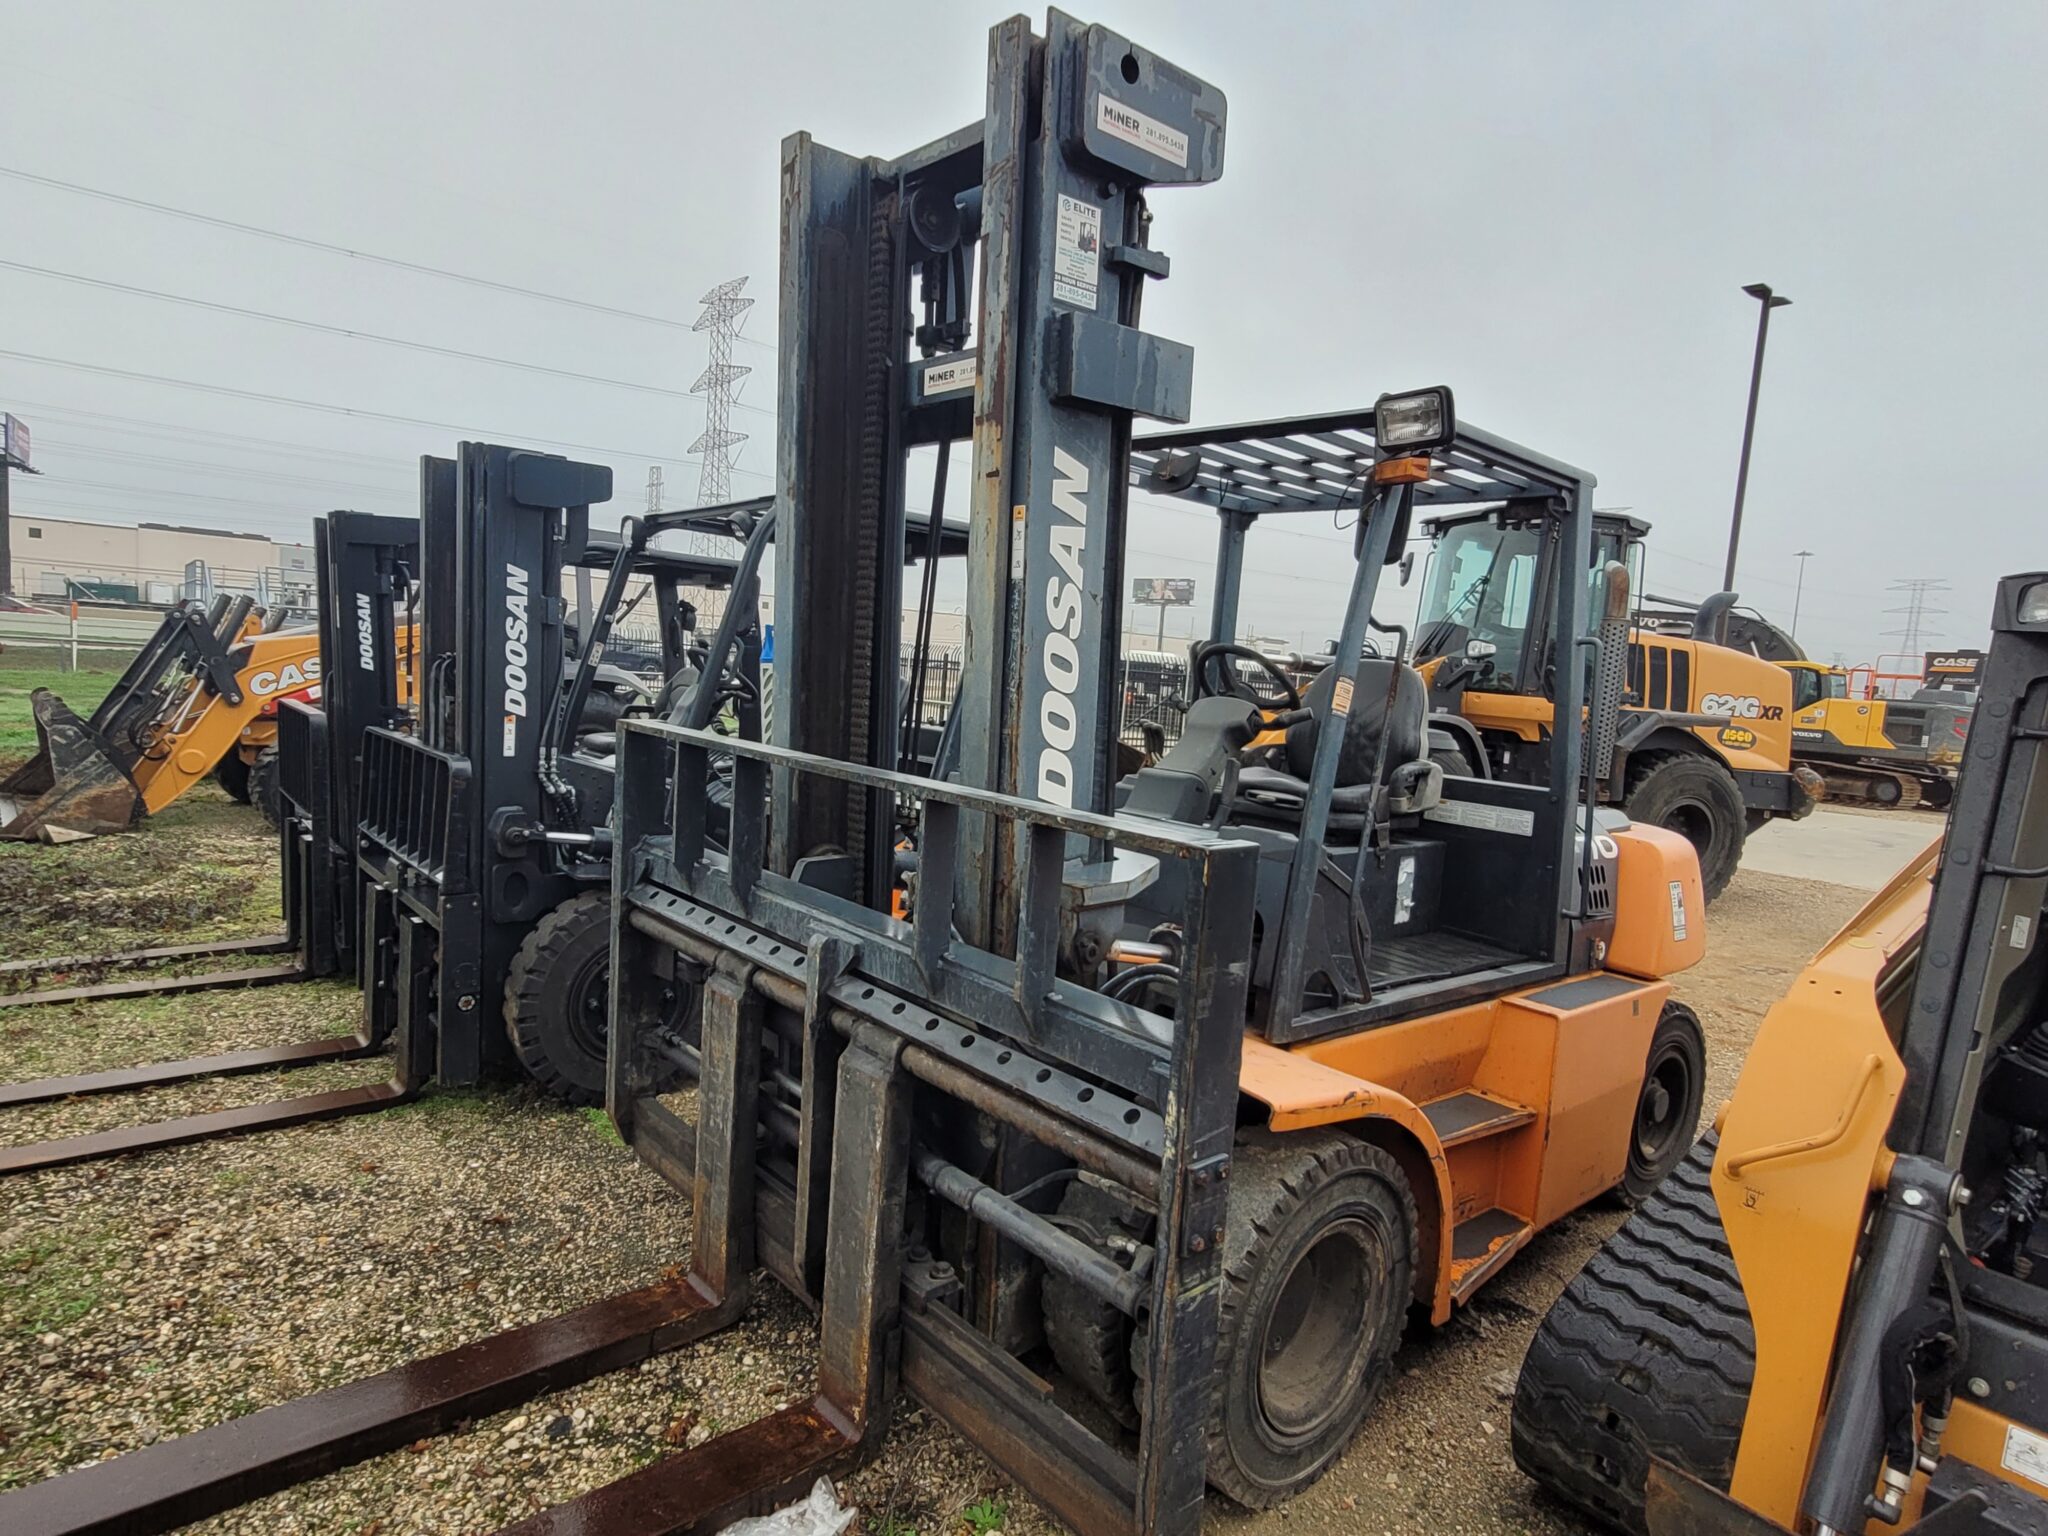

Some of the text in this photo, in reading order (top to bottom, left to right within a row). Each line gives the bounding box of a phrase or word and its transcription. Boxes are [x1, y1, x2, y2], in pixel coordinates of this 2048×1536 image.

[356, 593, 374, 671] DOOSAN
[504, 563, 528, 717] DOOSAN
[1038, 445, 1089, 809] DOOSAN
[250, 656, 320, 695] CAS
[1933, 657, 1979, 667] CASE
[1701, 693, 1783, 720] 621G XR
